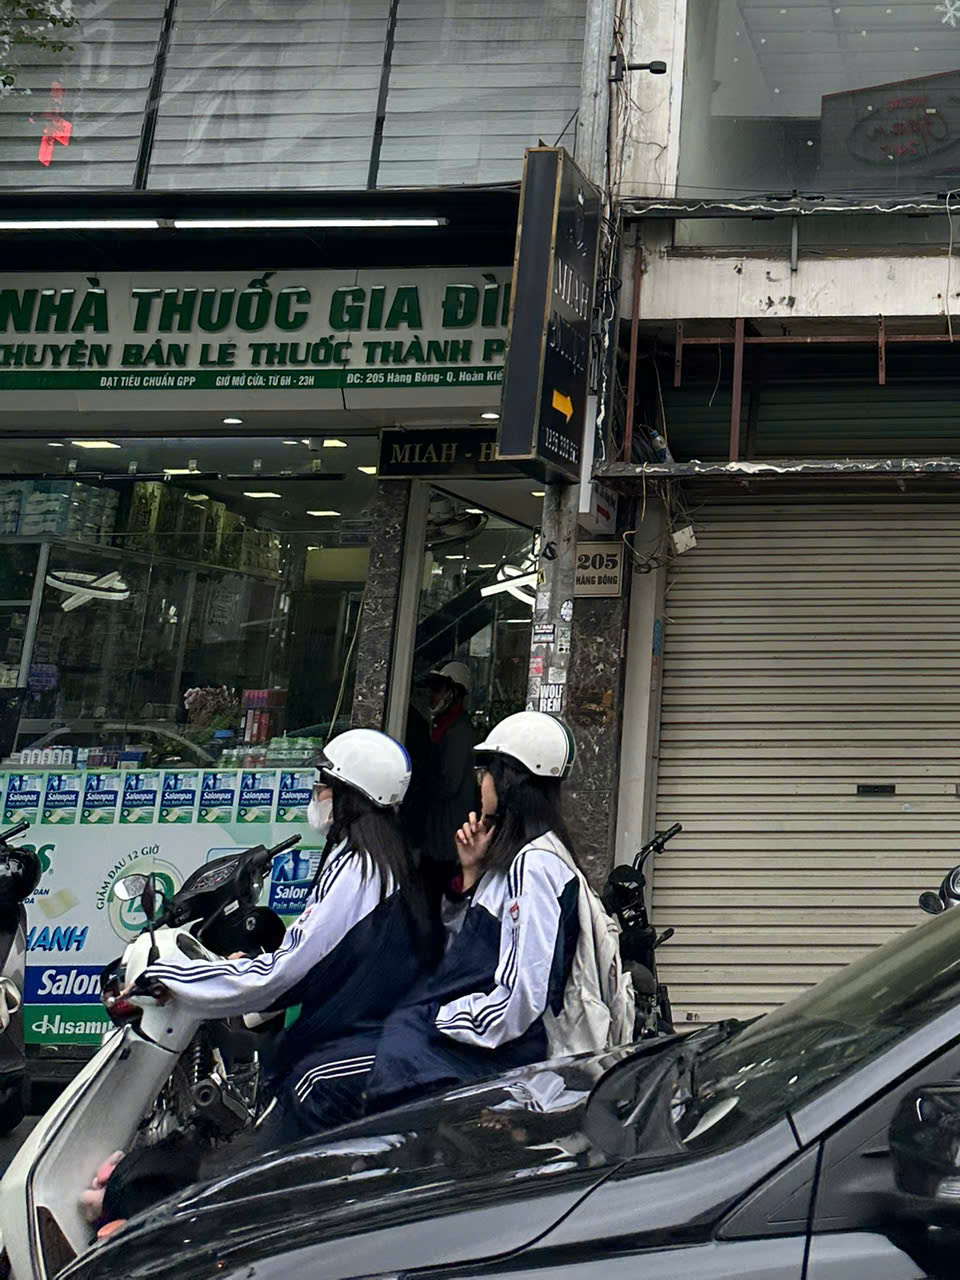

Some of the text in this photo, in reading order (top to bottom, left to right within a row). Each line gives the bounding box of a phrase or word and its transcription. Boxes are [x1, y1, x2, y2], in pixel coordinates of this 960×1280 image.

[0, 272, 512, 333] NHÀ THUỐC GIA ĐÌ
[362, 335, 472, 364] THÀNH
[100, 376, 119, 388] ĐẠT
[121, 374, 140, 387] TIÊU
[177, 376, 196, 387] GPP
[280, 376, 291, 386] 6H
[298, 376, 315, 386] 23H
[346, 373, 363, 384] ĐC:
[366, 372, 384, 384] 205
[387, 372, 412, 385] Hàng
[459, 371, 484, 382] Hoàn
[389, 442, 458, 464] MIAH
[577, 553, 618, 570] 205
[540, 685, 563, 699] WOLF
[539, 699, 561, 712] REM
[107, 858, 127, 880] ĐAU
[127, 850, 139, 861] 12
[141, 844, 160, 856] GIỜ
